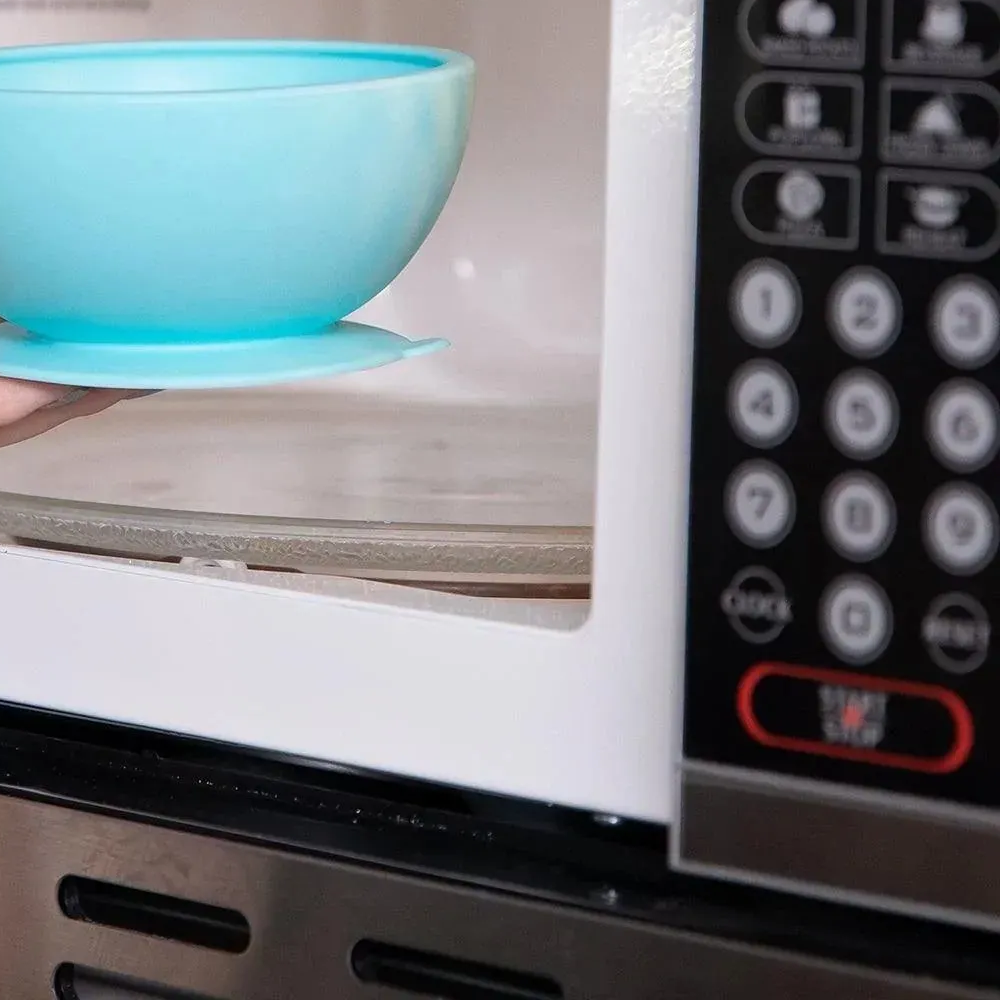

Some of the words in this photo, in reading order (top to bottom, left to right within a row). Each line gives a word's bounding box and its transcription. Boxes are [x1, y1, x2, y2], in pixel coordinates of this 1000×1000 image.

[760, 287, 772, 321] 1
[854, 294, 879, 330] 2
[953, 302, 981, 341] 3
[750, 388, 774, 419] 4
[849, 399, 876, 433] 5
[953, 410, 979, 443] 6
[750, 486, 773, 520] 7
[949, 509, 977, 545] 9
